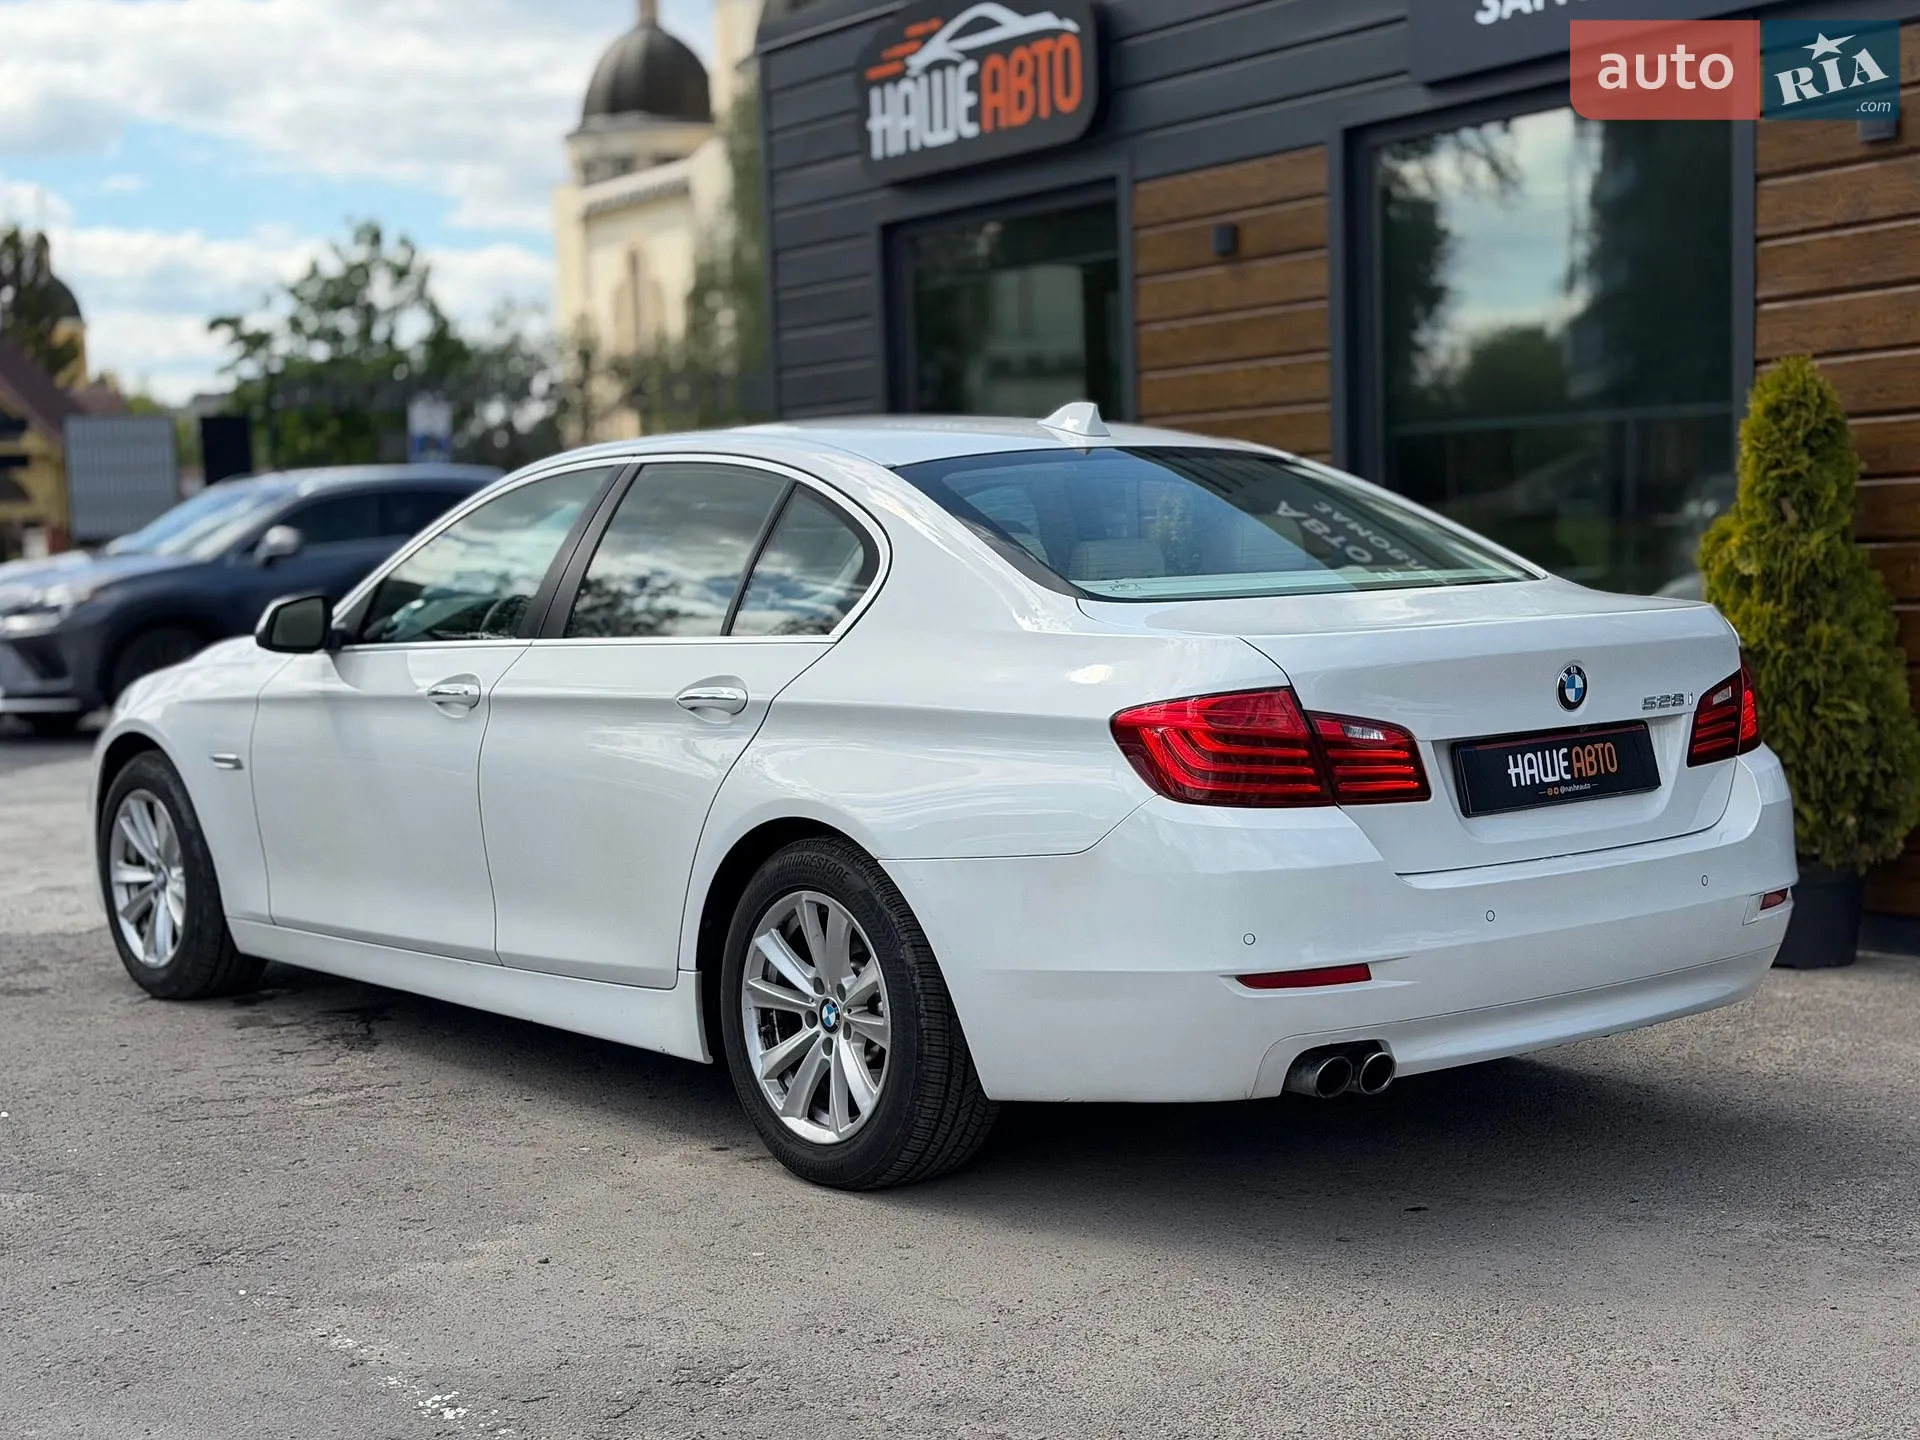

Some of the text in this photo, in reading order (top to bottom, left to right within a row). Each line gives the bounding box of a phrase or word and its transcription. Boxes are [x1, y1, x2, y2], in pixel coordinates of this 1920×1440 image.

[866, 33, 1082, 160] НАШЕ АВТО
[1507, 741, 1618, 787] НАШЕ АВТО
